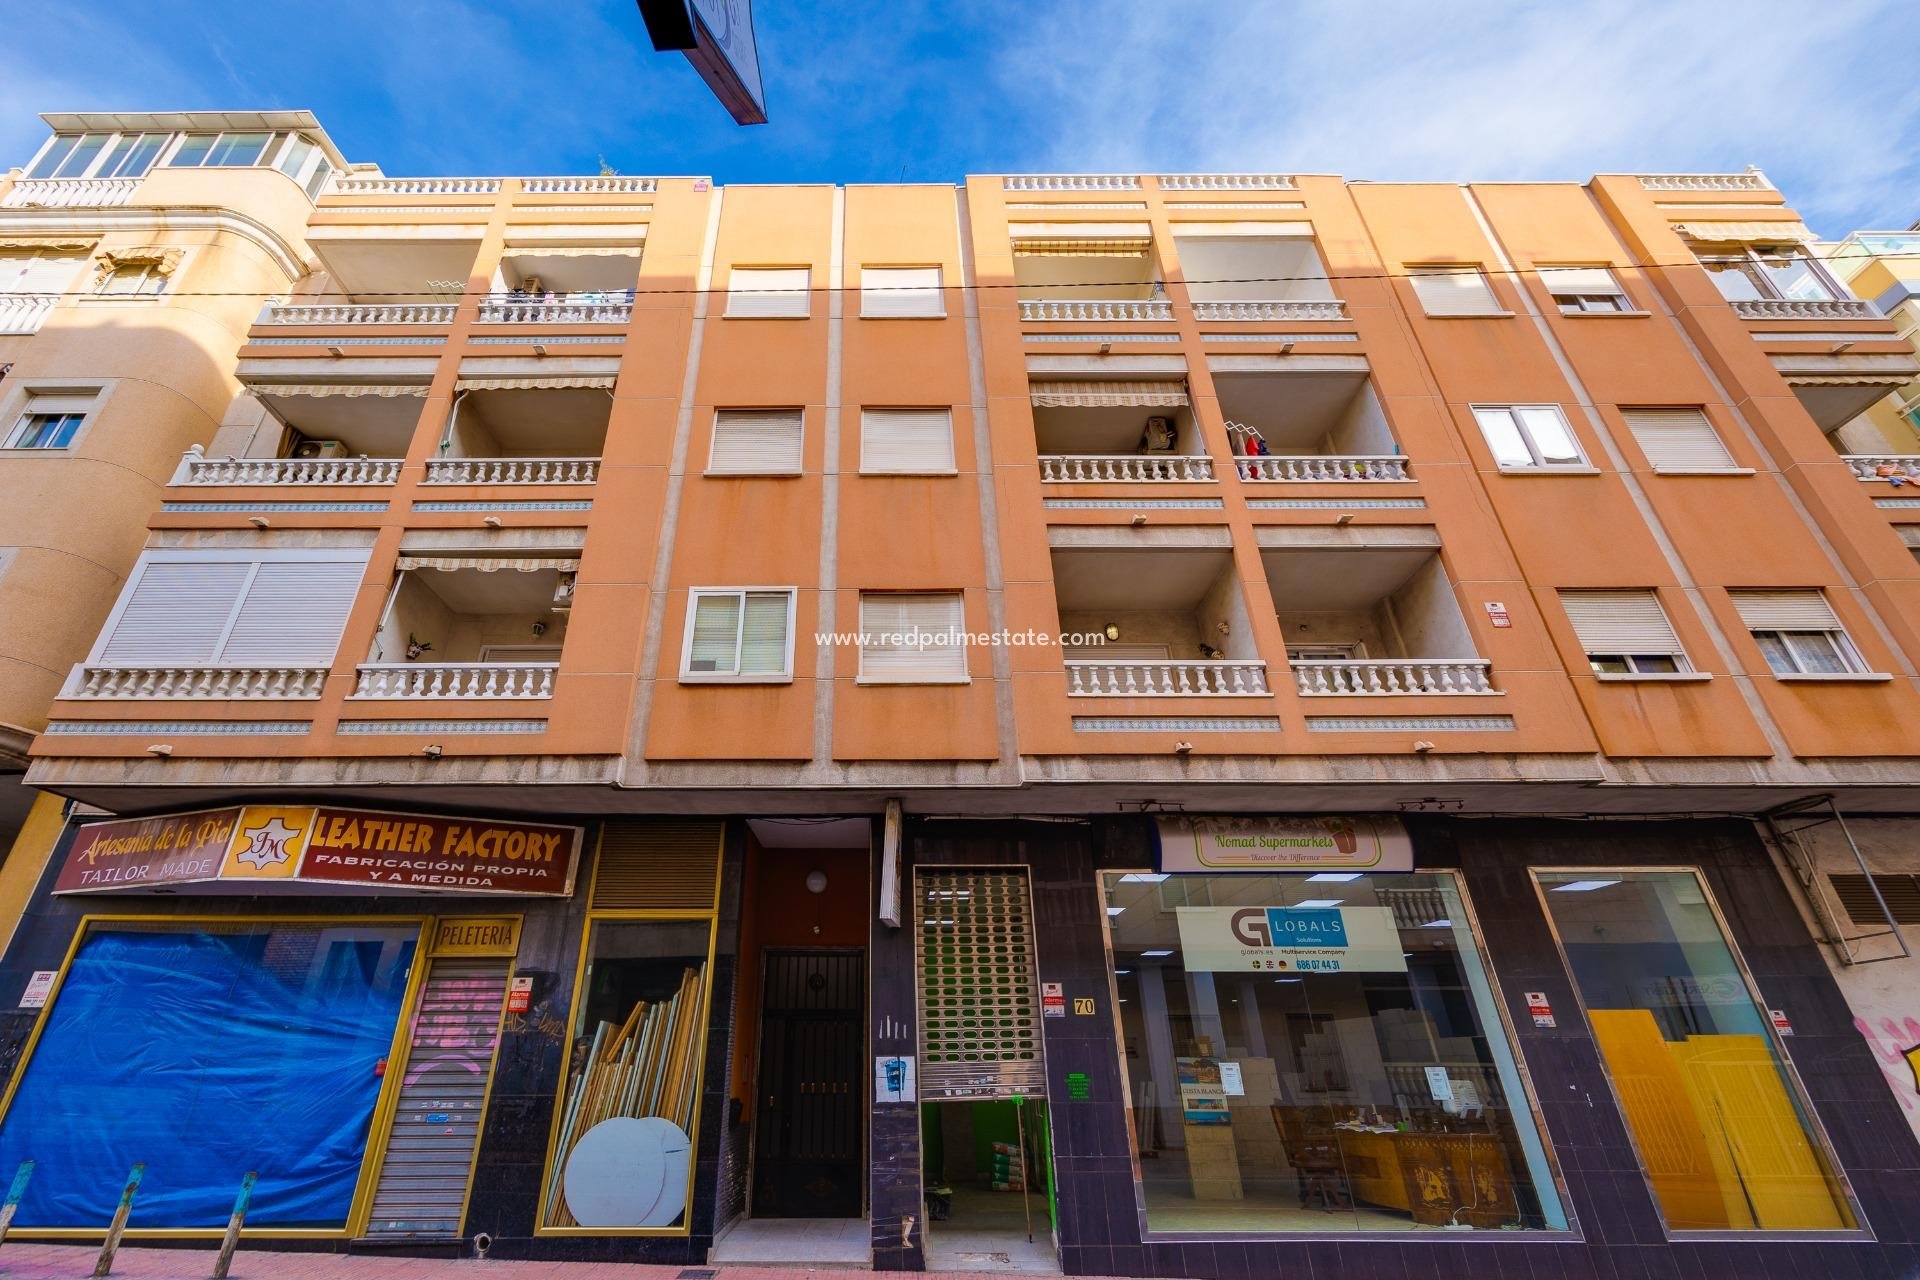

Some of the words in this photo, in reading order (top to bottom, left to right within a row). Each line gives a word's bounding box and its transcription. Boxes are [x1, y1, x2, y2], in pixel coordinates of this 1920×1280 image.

[156, 831, 173, 850] de
[174, 827, 191, 848] la
[310, 816, 434, 853] LEATHER
[441, 825, 561, 862] FACTORY
[1215, 835, 1256, 848] Nomad
[1260, 835, 1333, 851] Supermarkets
[80, 865, 149, 885] TAILOR
[160, 859, 212, 876] MADE
[314, 854, 464, 872] FABRICACIÓN
[473, 864, 548, 877] PROPIA
[369, 871, 384, 881] Y
[387, 872, 402, 881] A
[411, 873, 493, 886] MEDIDA
[440, 925, 512, 945] PELETERIA
[1076, 999, 1093, 1014] 70
